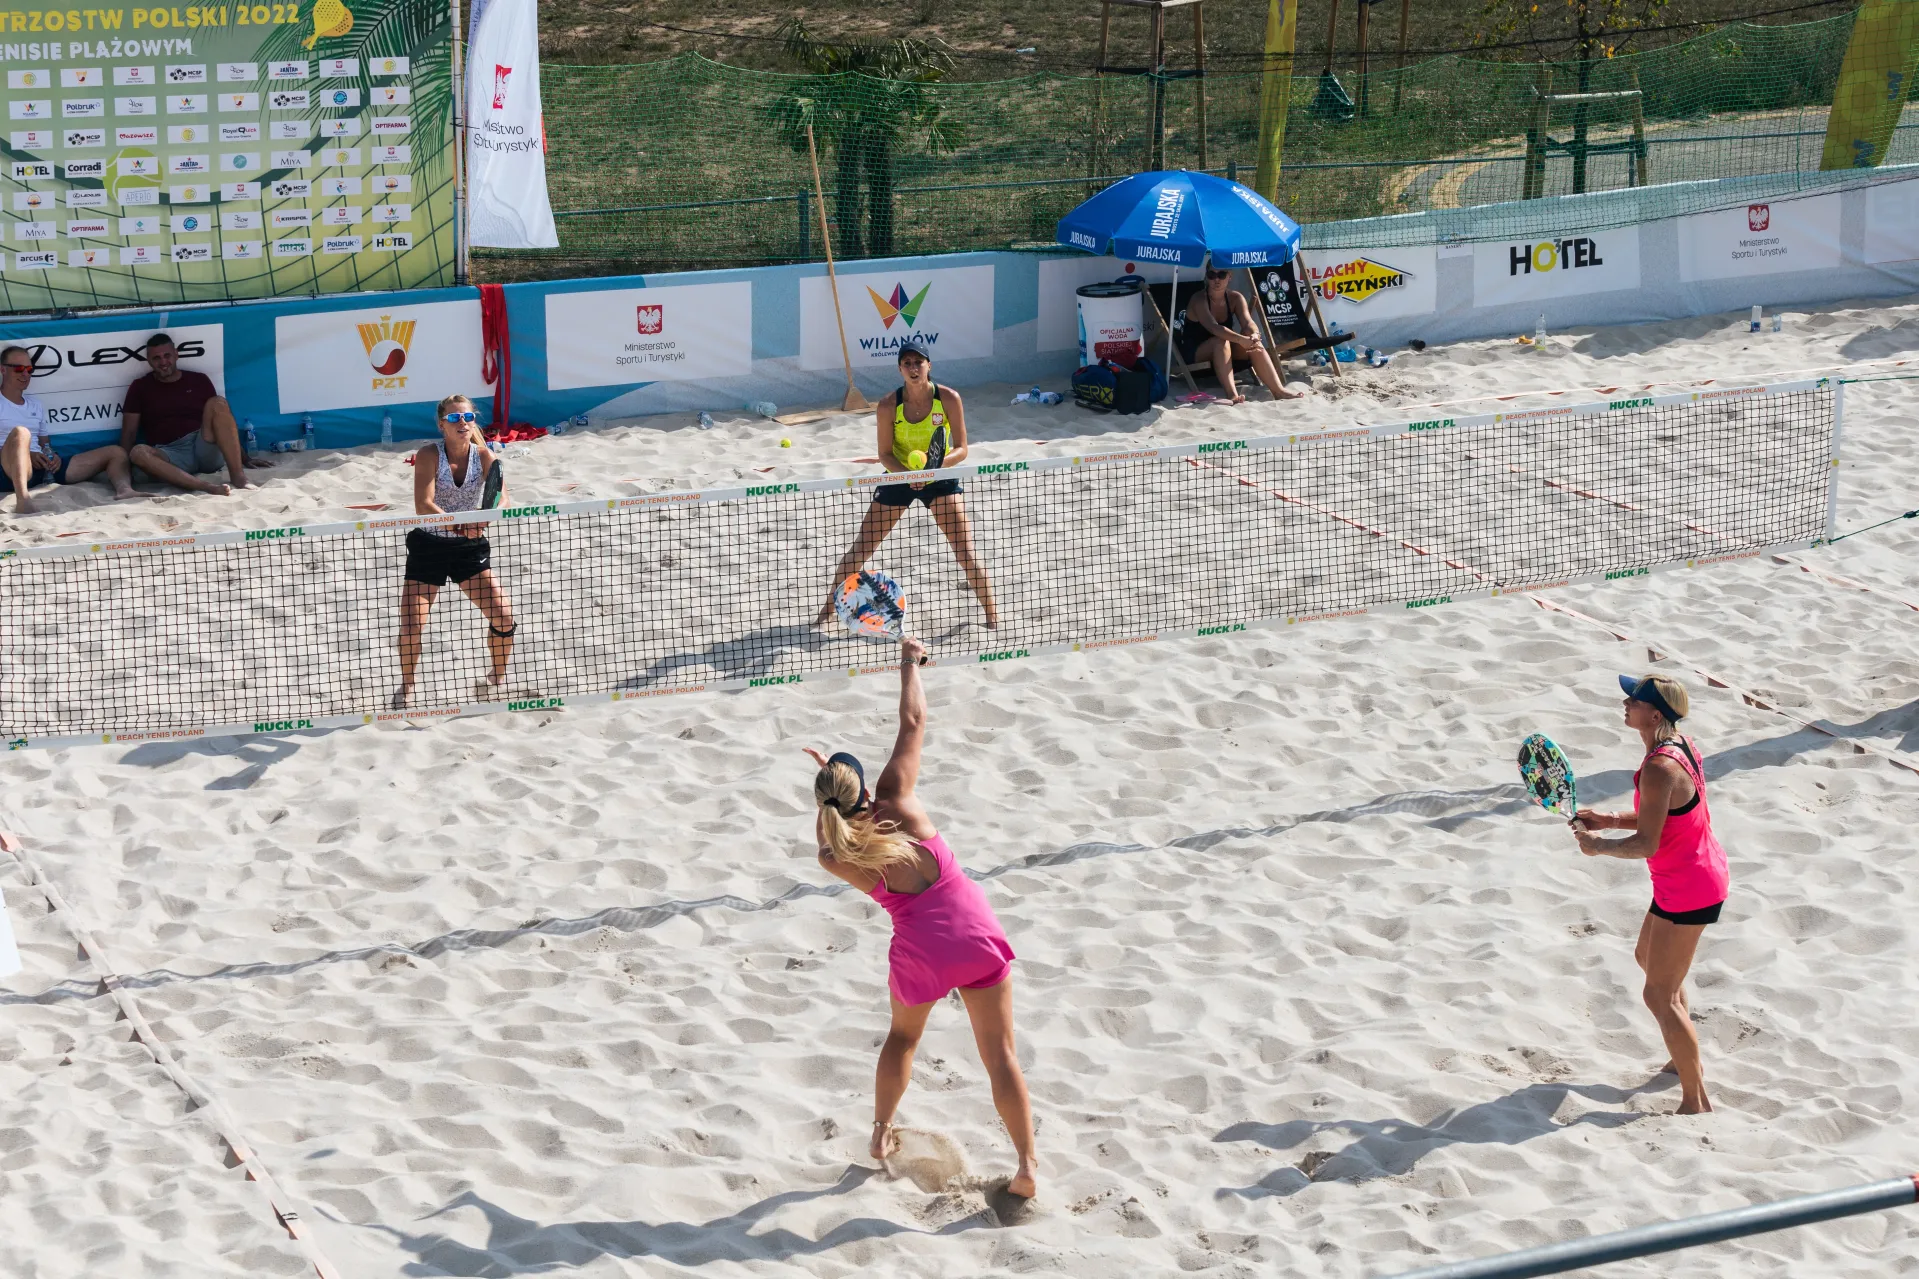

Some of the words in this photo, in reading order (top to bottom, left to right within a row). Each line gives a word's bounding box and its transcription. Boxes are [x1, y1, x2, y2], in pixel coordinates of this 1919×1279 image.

[132, 6, 226, 29] POLSKI
[237, 4, 299, 25] 2022
[70, 37, 194, 59] PLAŻOWYM
[68, 162, 102, 172] Corradi
[1150, 188, 1180, 239] JURAJSKA
[1070, 231, 1096, 249] JURAJSKA
[1739, 237, 1779, 247] Ministerstwo
[1136, 245, 1181, 262] JURAJSKA
[1232, 252, 1268, 265] JURAJSKA
[1732, 249, 1754, 260] Sportu
[1759, 246, 1787, 257] Turystyki
[1300, 274, 1403, 300] PRUSZYŃSKI
[1266, 302, 1292, 315] MCSP
[624, 342, 675, 352] Ministerstwo
[859, 330, 939, 350] WILANÓW
[616, 356, 642, 366] Sportu
[649, 352, 685, 363] Turystyki
[372, 376, 408, 390] PZT
[907, 472, 934, 482] POLAND
[370, 520, 397, 528] BEACH
[423, 516, 455, 524] POLAND
[430, 708, 460, 716] POLAND
